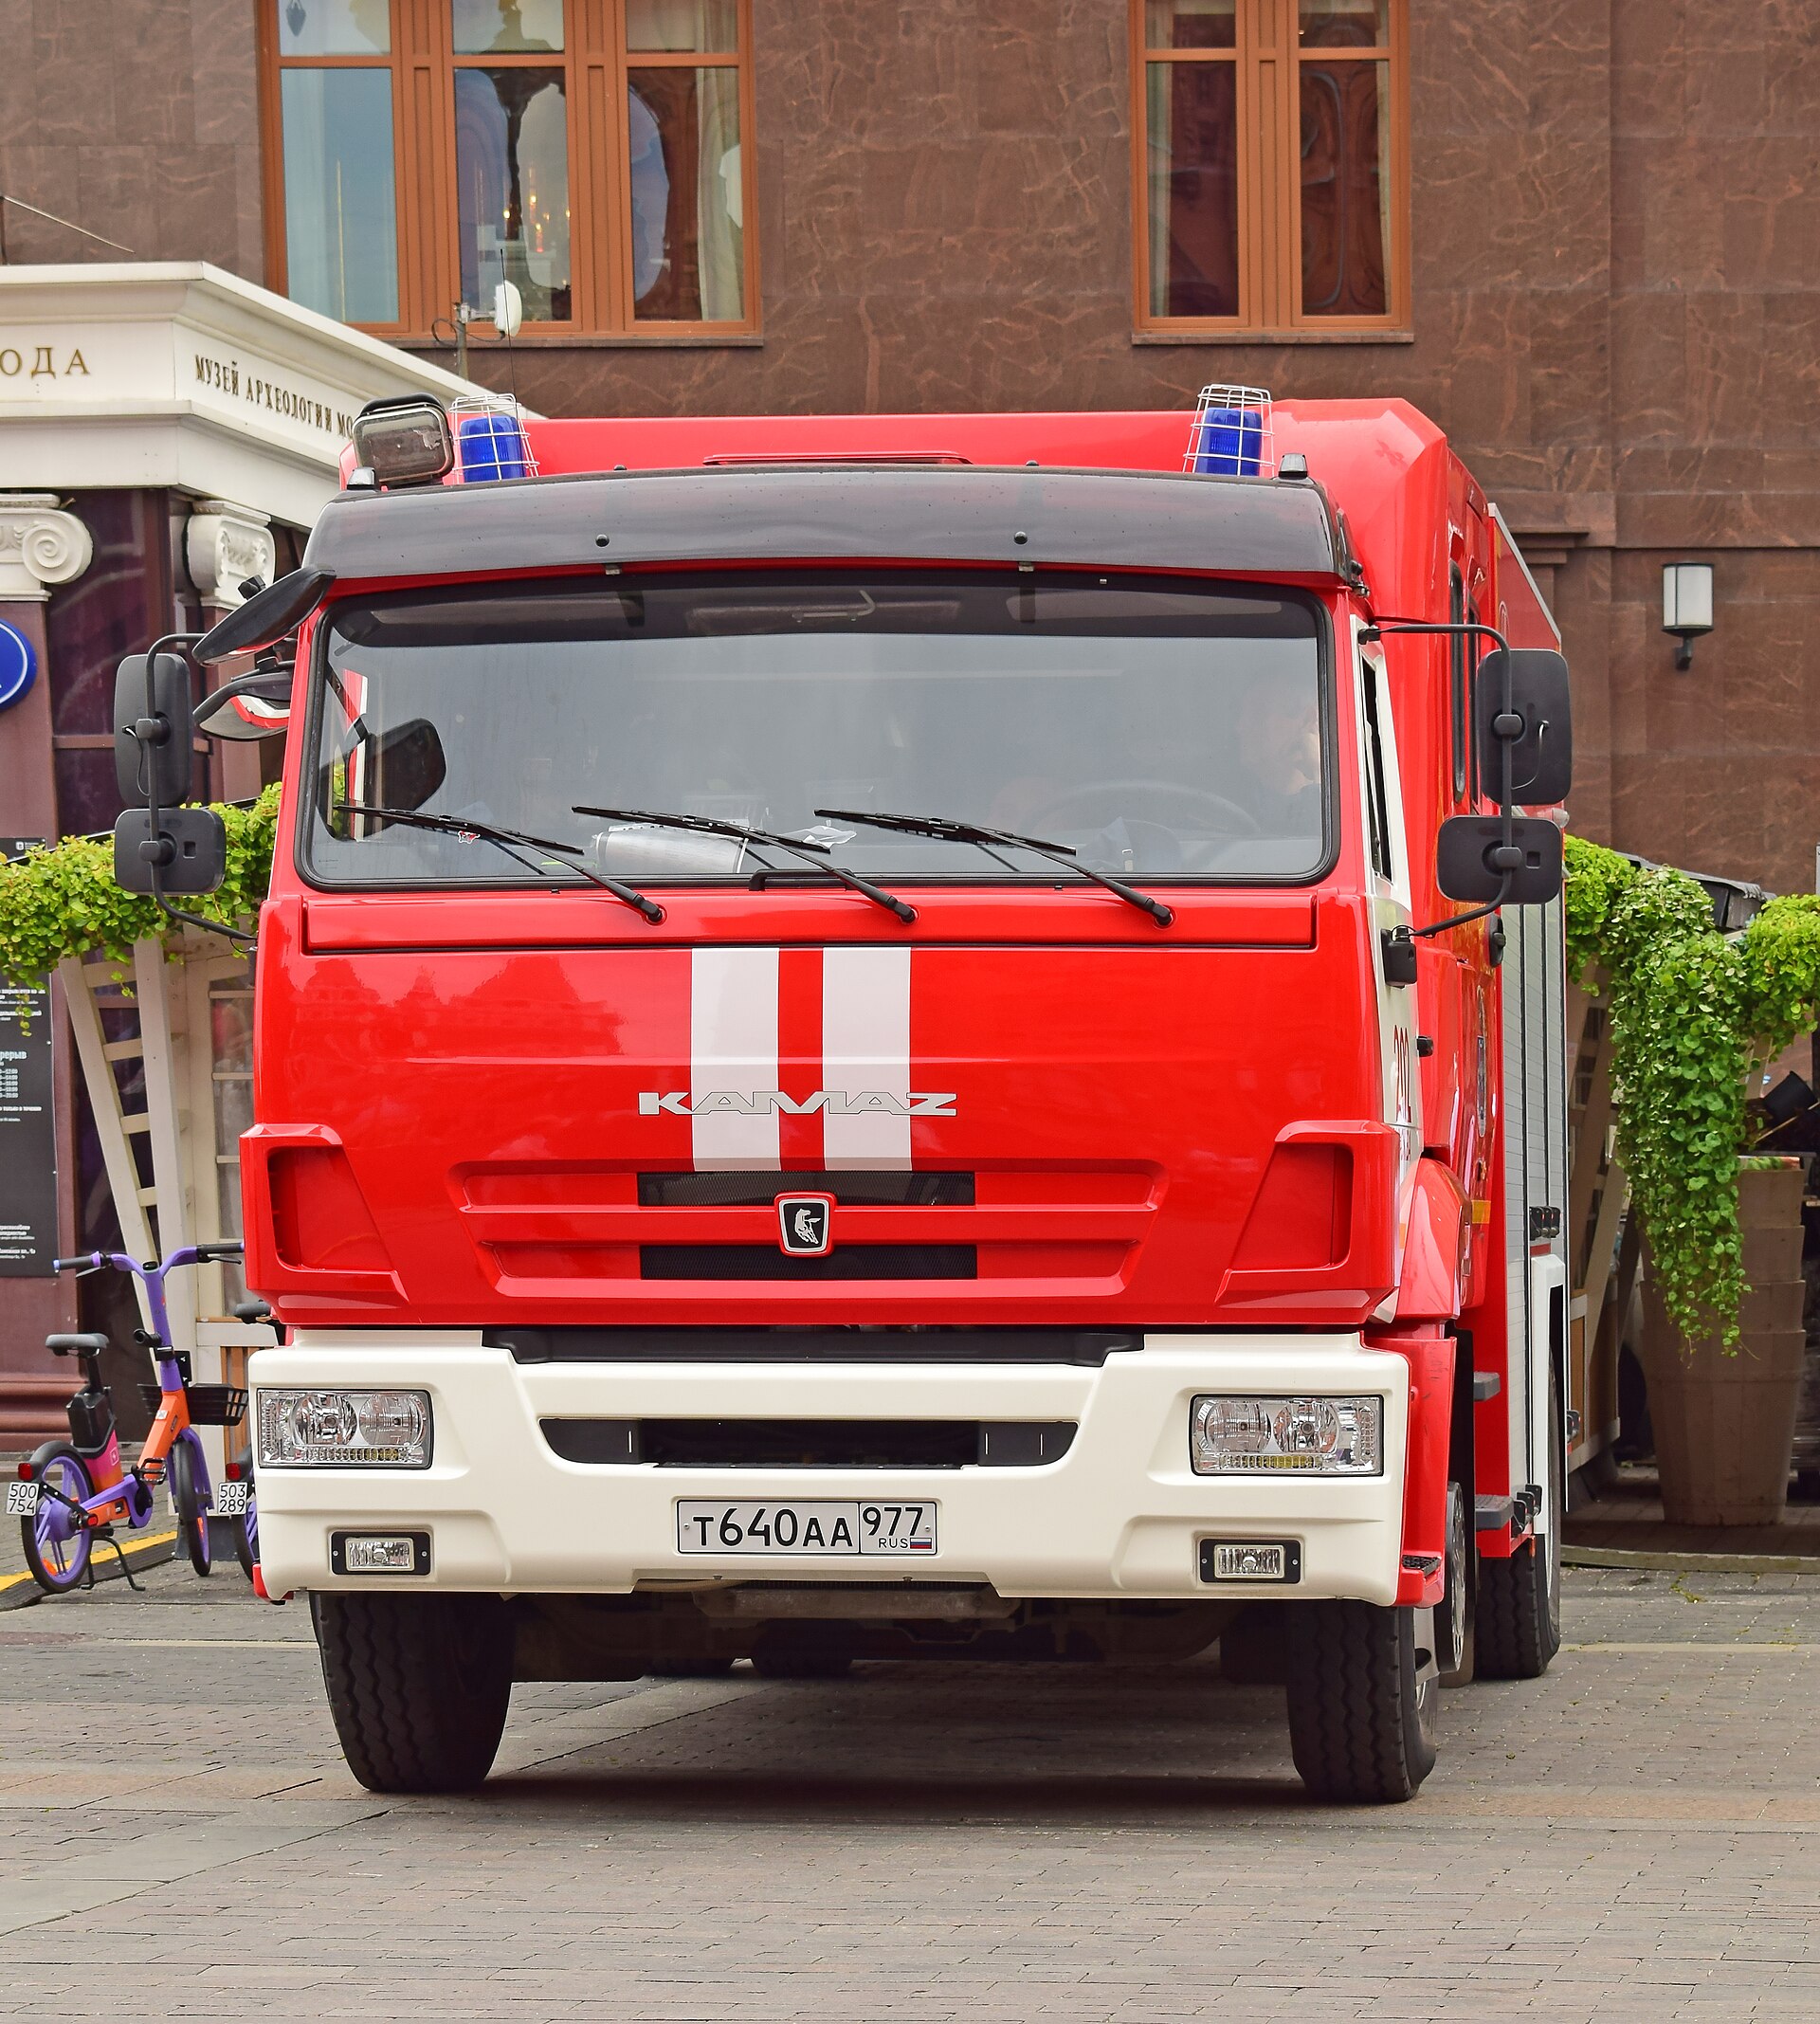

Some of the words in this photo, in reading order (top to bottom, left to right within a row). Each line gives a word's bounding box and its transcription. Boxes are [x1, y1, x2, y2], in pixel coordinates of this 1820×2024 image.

[195, 354, 240, 396] МУЗЕЙ
[246, 376, 333, 433] АРХЕОЛОГИИ
[639, 1091, 956, 1116] KAMAZ
[9, 1484, 37, 1499] 500
[219, 1484, 246, 1498] 503
[9, 1498, 35, 1514] 754
[219, 1499, 246, 1513] 289
[862, 1506, 923, 1536] 977
[878, 1538, 908, 1549] RUS
